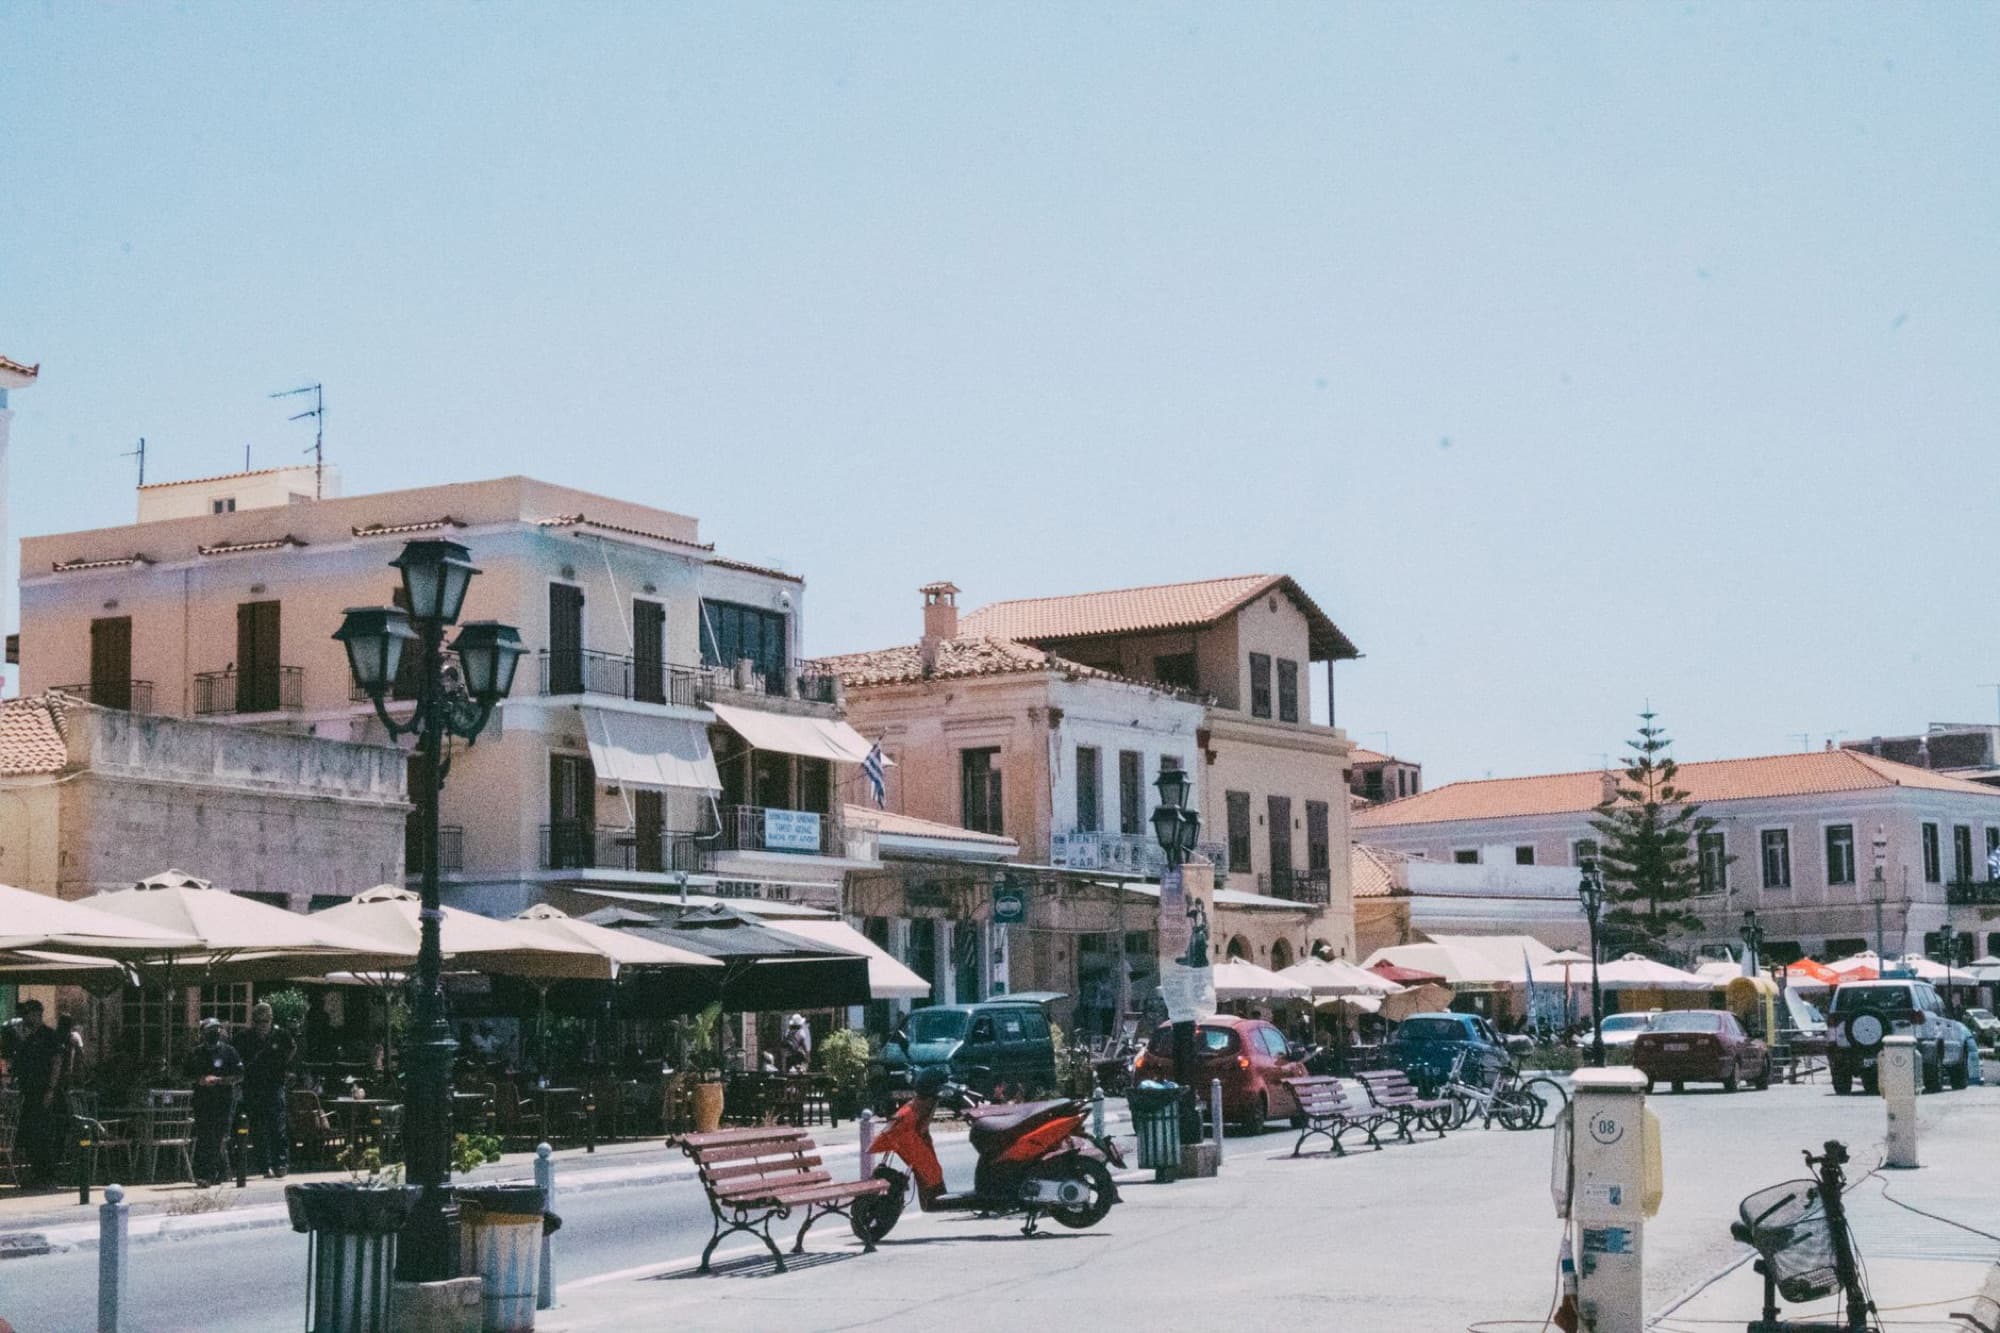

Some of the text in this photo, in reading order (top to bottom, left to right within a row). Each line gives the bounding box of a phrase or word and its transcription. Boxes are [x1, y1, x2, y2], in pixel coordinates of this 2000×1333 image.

[1068, 834, 1097, 844] RENT
[1070, 856, 1093, 866] CAR
[716, 880, 761, 898] GREEK
[1599, 1120, 1615, 1135] 08
